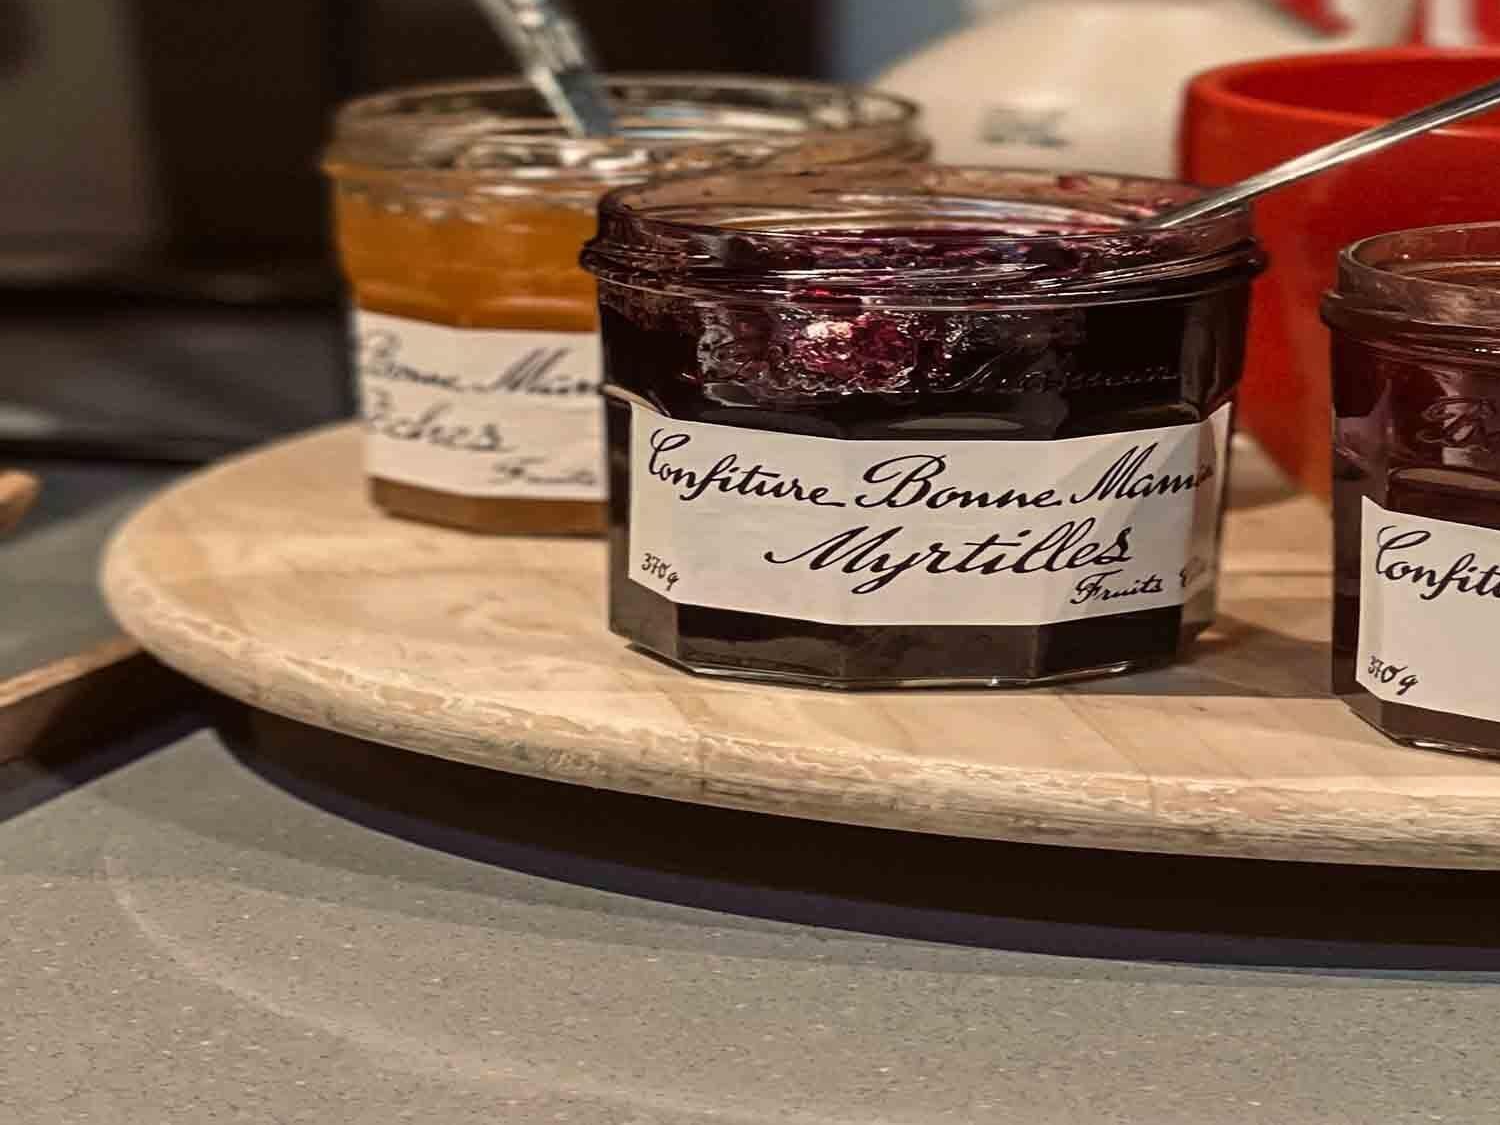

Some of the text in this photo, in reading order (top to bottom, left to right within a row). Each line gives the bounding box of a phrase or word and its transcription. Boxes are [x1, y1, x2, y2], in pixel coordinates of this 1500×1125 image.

[648, 427, 847, 510] Confiture
[854, 453, 1063, 511] Bonne
[763, 517, 1134, 595] Myrtilles
[1069, 568, 1164, 605] Fruits
